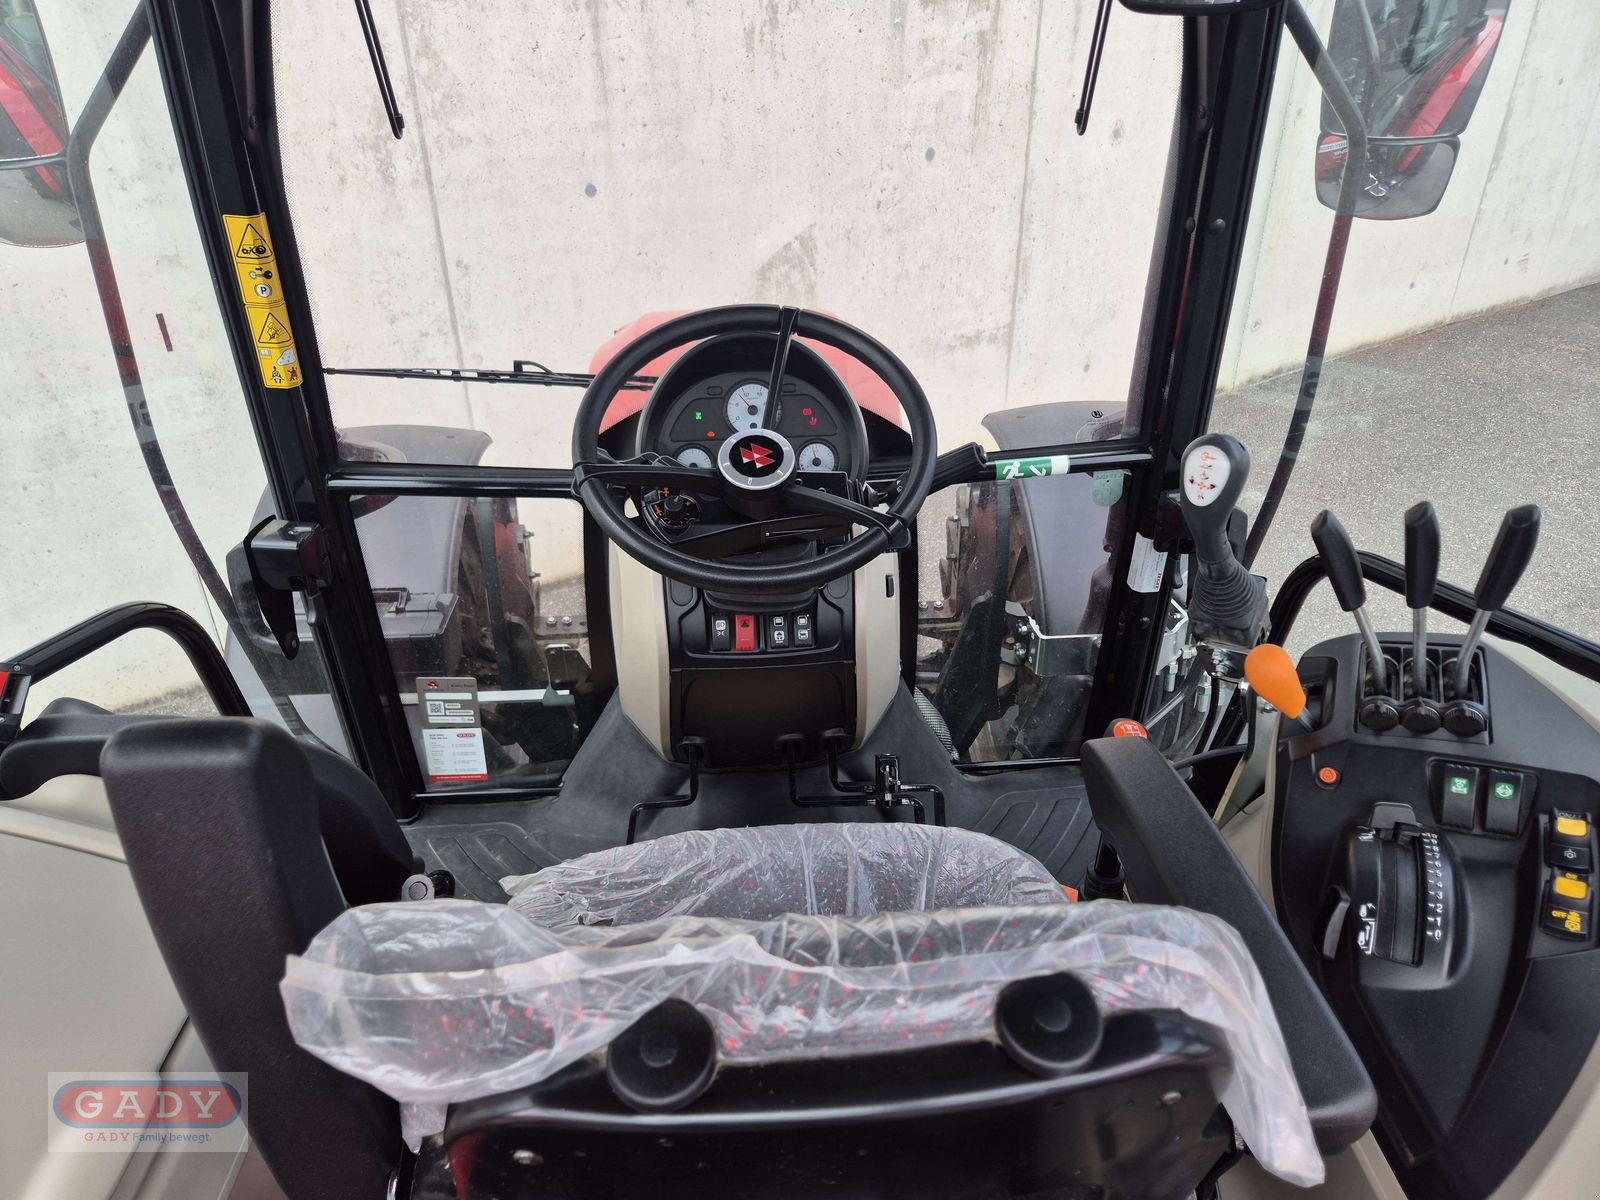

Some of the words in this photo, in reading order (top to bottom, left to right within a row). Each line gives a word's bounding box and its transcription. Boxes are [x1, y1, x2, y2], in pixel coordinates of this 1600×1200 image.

[1551, 910, 1568, 919] OFF
[1436, 916, 1442, 927] 1
[1434, 929, 1442, 940] 0
